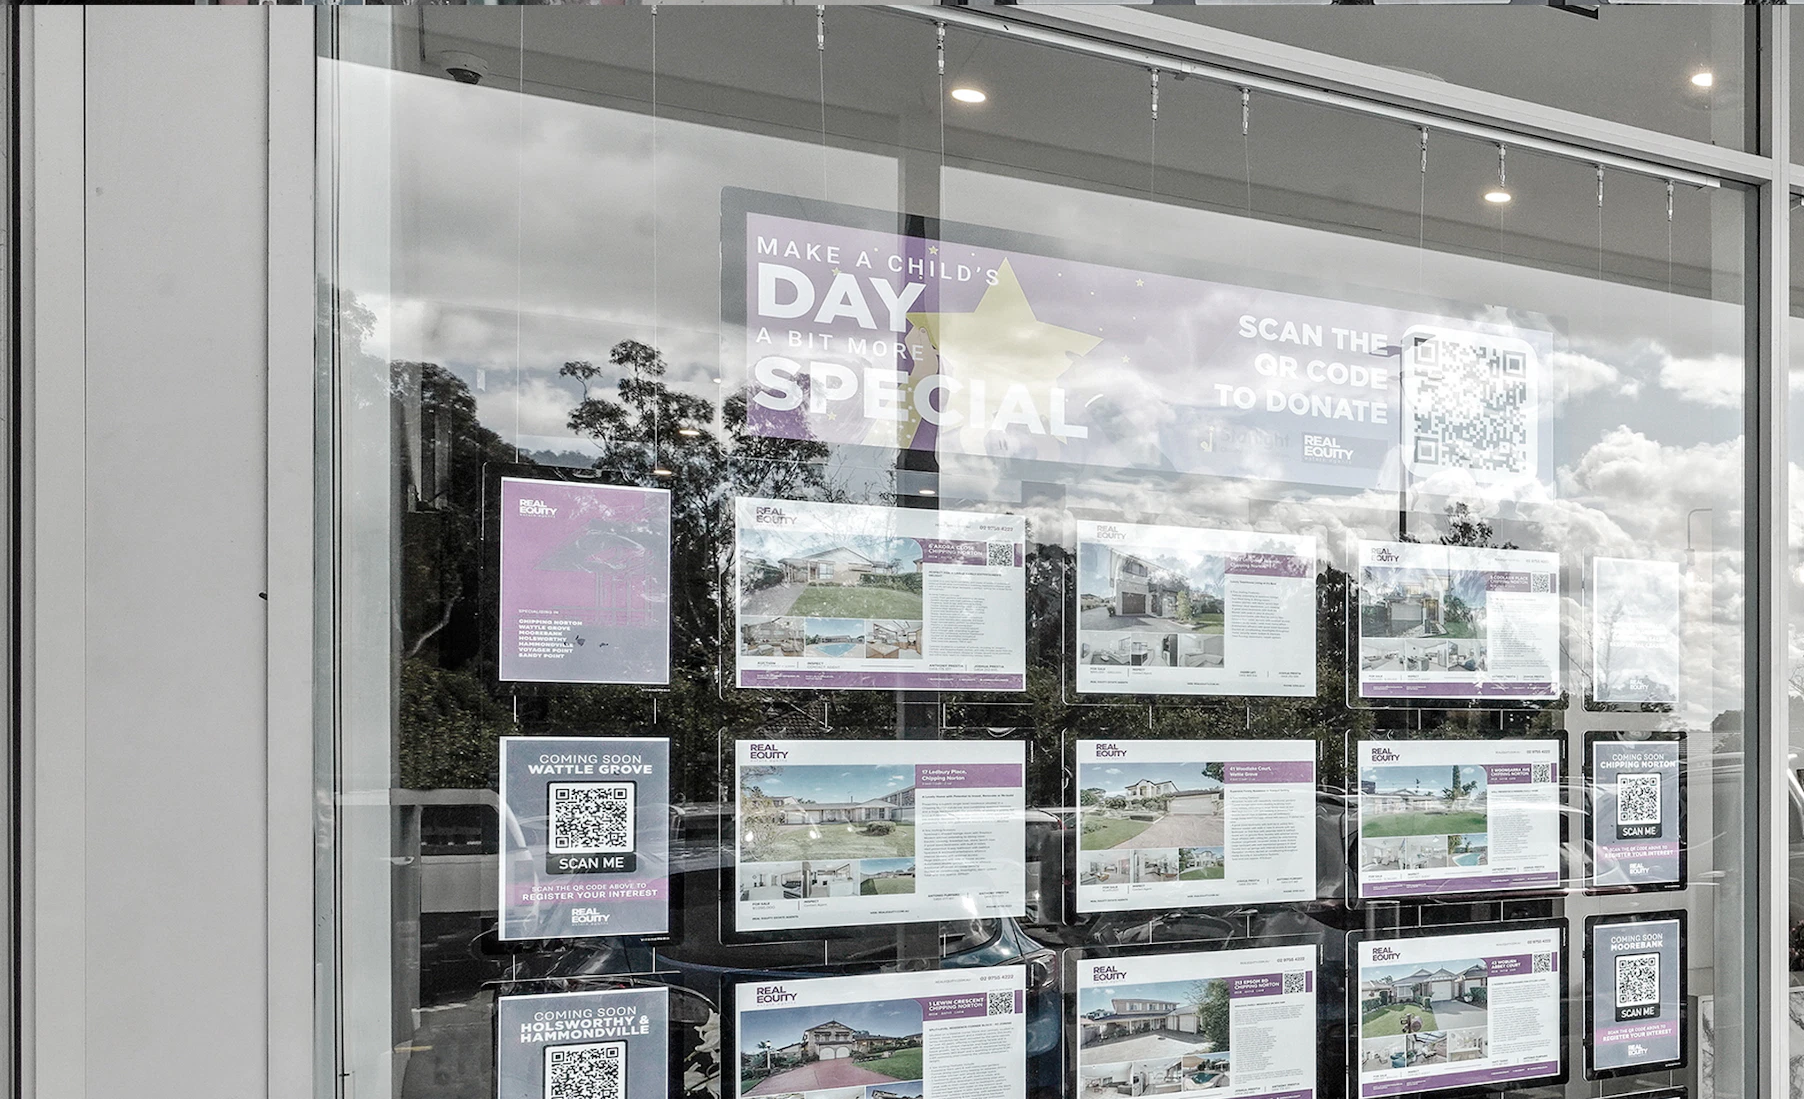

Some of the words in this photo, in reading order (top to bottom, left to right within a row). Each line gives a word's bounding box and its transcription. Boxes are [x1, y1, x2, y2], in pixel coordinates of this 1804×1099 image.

[758, 237, 840, 264] MAKE
[856, 252, 872, 268] A
[888, 255, 999, 286] CHILD'S
[758, 263, 926, 333] DAY
[1239, 315, 1322, 347] SCAN
[1332, 327, 1388, 355] THE
[756, 328, 772, 344] A
[789, 331, 833, 350] BIT
[848, 337, 924, 361] MORE
[1255, 353, 1298, 379] QR
[1307, 360, 1388, 389] CODE
[753, 356, 1088, 439] SPECIAL
[1214, 384, 1256, 409] TO
[1266, 390, 1388, 424] DONATE
[1304, 435, 1340, 448] REAL
[1304, 445, 1354, 461] EQUITY
[520, 499, 547, 507] REAL
[520, 506, 557, 516] EQUITY
[756, 506, 785, 515] REAL
[540, 755, 598, 764] COMING
[603, 755, 642, 764] SOON
[750, 751, 788, 759] EQUITY
[1372, 754, 1400, 762] EQUITY
[529, 765, 593, 774] WATTLE
[599, 765, 653, 774] GROVE
[1623, 827, 1643, 836] SCAN
[1645, 827, 1656, 835] ME
[559, 858, 598, 869] SCAN
[603, 857, 624, 868] ME
[523, 892, 573, 901] REGISTER
[577, 891, 605, 899] YOUR
[609, 889, 658, 897] INTEREST
[572, 908, 599, 916] REAL
[572, 915, 610, 923] EQUITY
[1611, 935, 1640, 943] COMING
[1372, 947, 1393, 955] REAL
[1611, 941, 1663, 951] MOOREBANK
[1372, 952, 1401, 962] EQUITY
[1093, 965, 1117, 974] REAL
[1093, 972, 1127, 981] EQUITY
[757, 986, 786, 995] REAL
[757, 993, 797, 1004] EQUITY
[534, 1009, 592, 1021] COMING
[597, 1006, 636, 1017] SOON
[1621, 1008, 1642, 1018] SCAN
[1643, 1007, 1654, 1015] ME
[521, 1016, 634, 1033] HOLSWORTHY
[639, 1015, 649, 1024] &
[521, 1025, 649, 1043] HAMMONDVILLE
[1603, 1034, 1629, 1042] REGISTER
